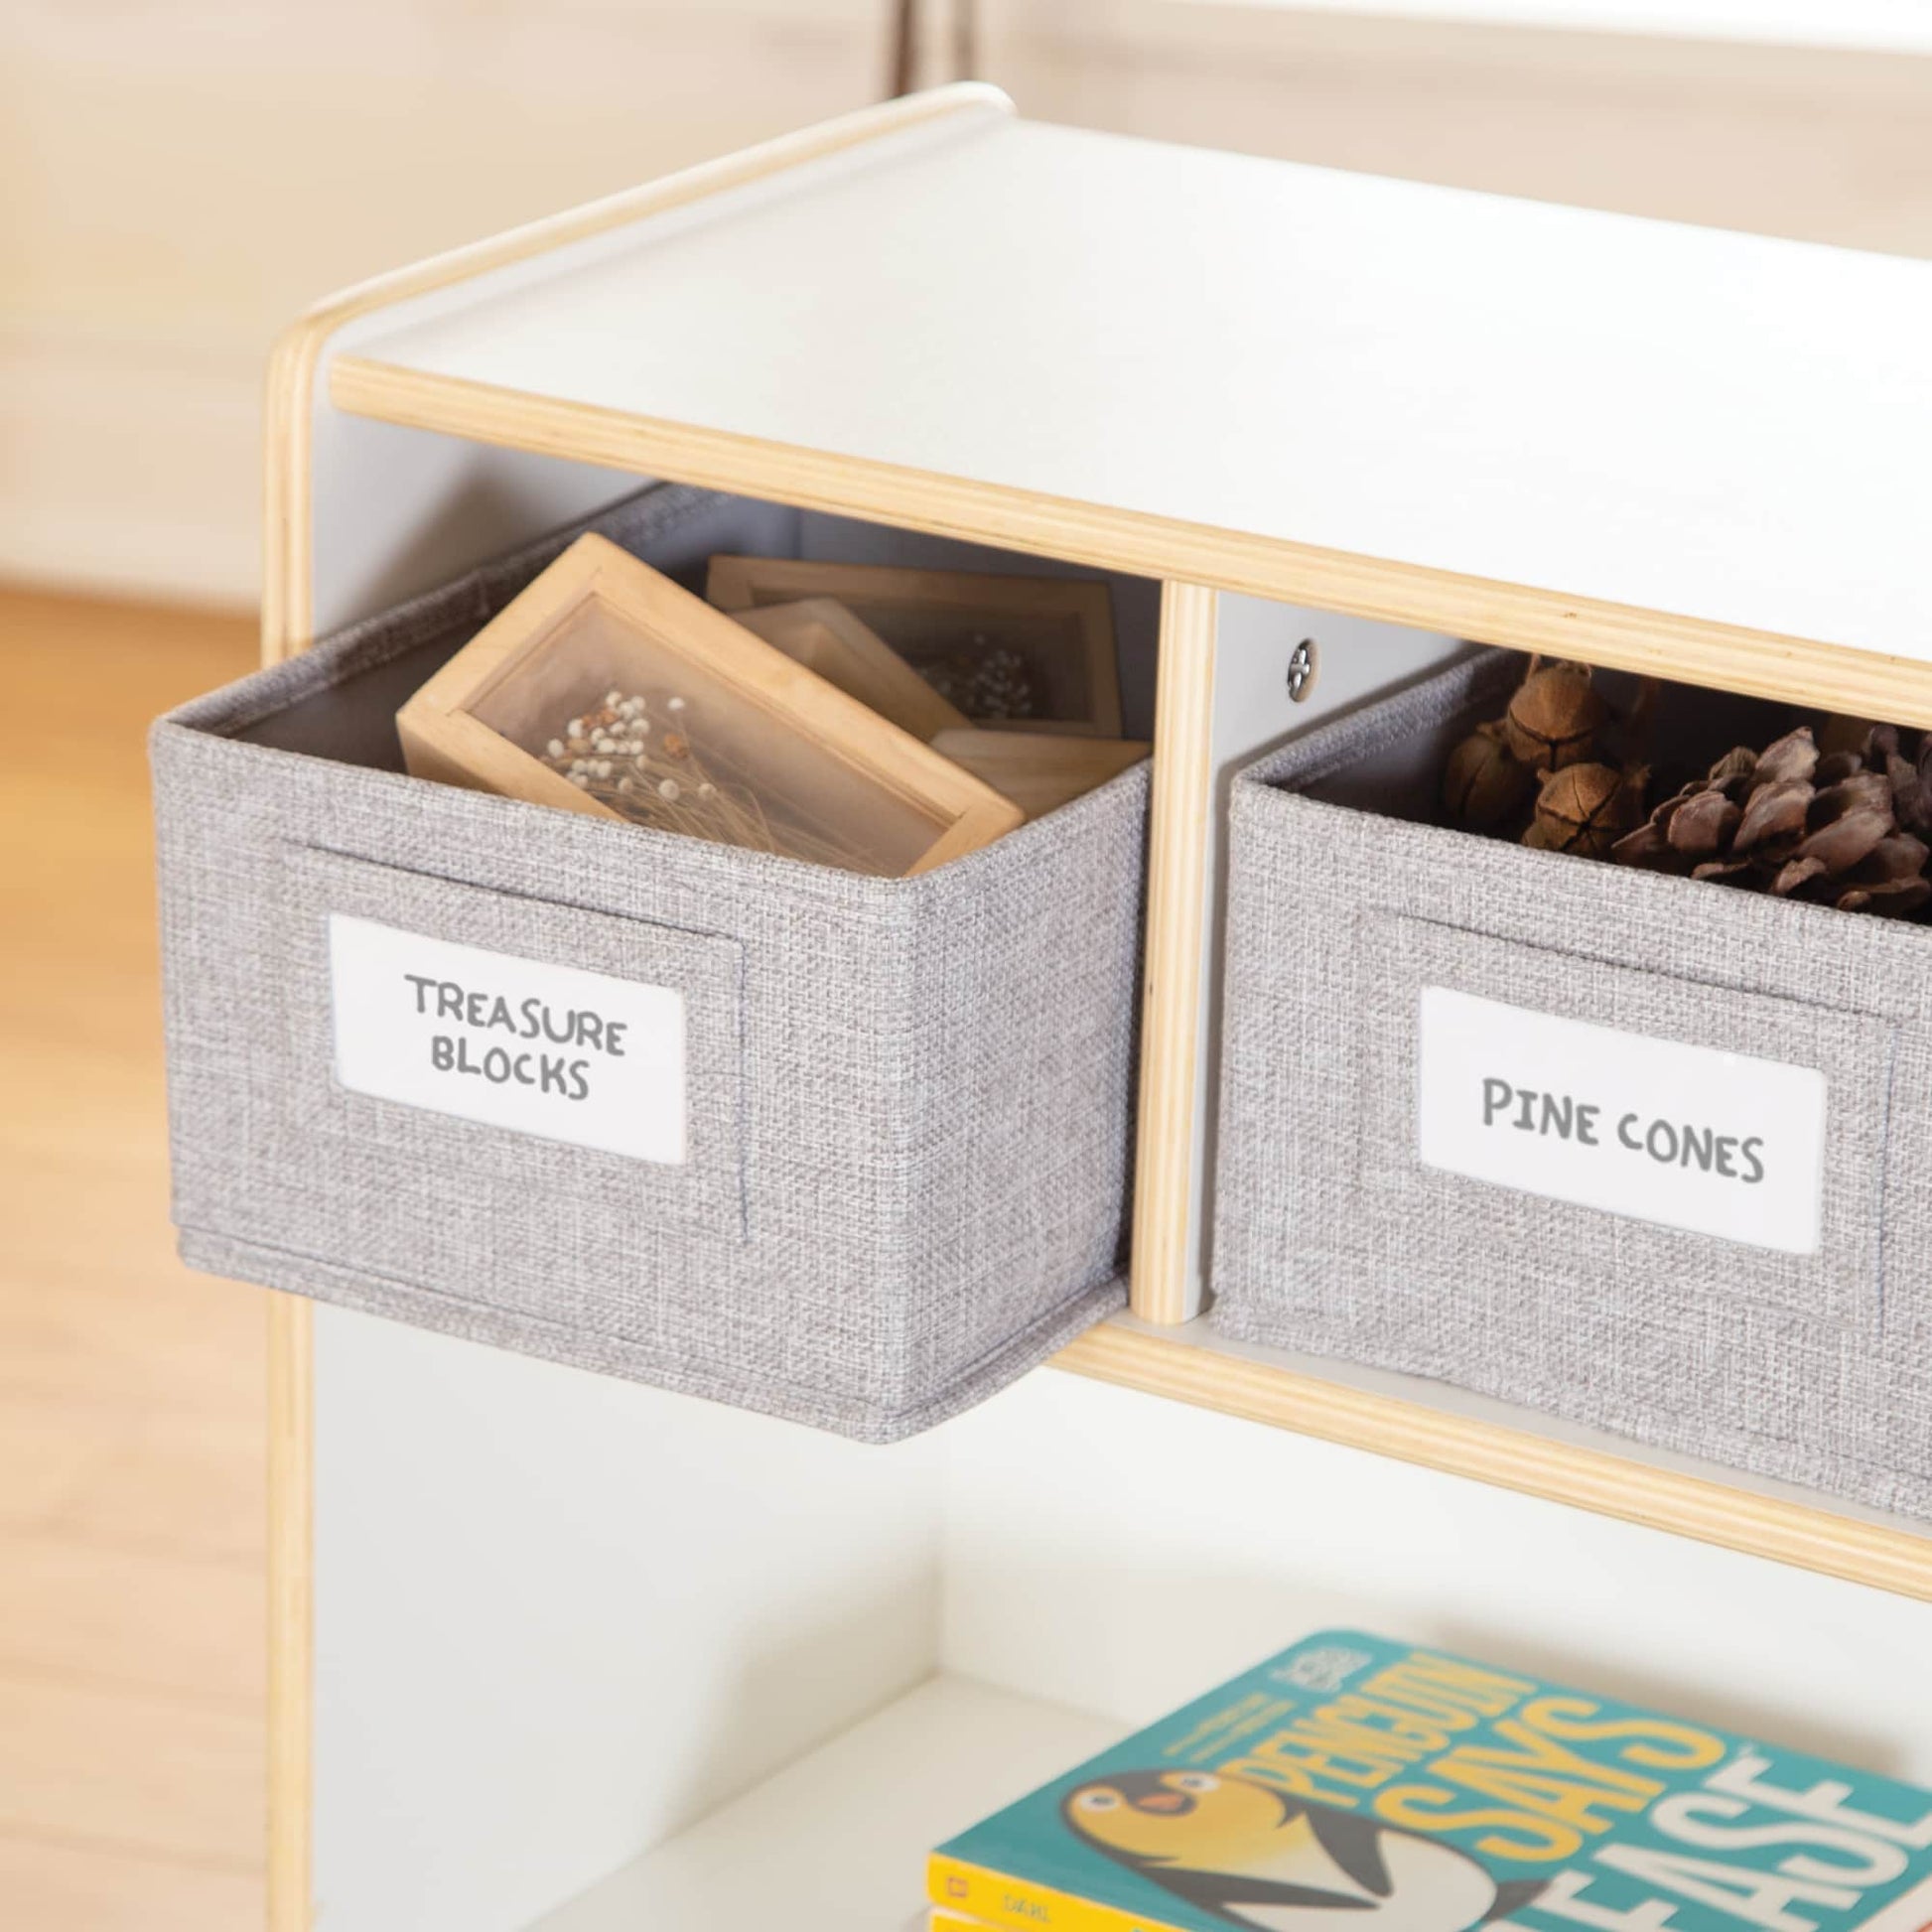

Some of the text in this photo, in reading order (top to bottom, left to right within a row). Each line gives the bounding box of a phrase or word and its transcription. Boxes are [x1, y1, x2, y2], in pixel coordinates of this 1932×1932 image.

[404, 974, 627, 1055] TREASURE
[432, 1035, 590, 1100] BLOCKS
[1483, 1078, 1764, 1183] PINE CONES
[1216, 1650, 1539, 1808] PENGUIN
[1373, 1697, 1725, 1862] SAYS
[1479, 1755, 1932, 1932] EASE
